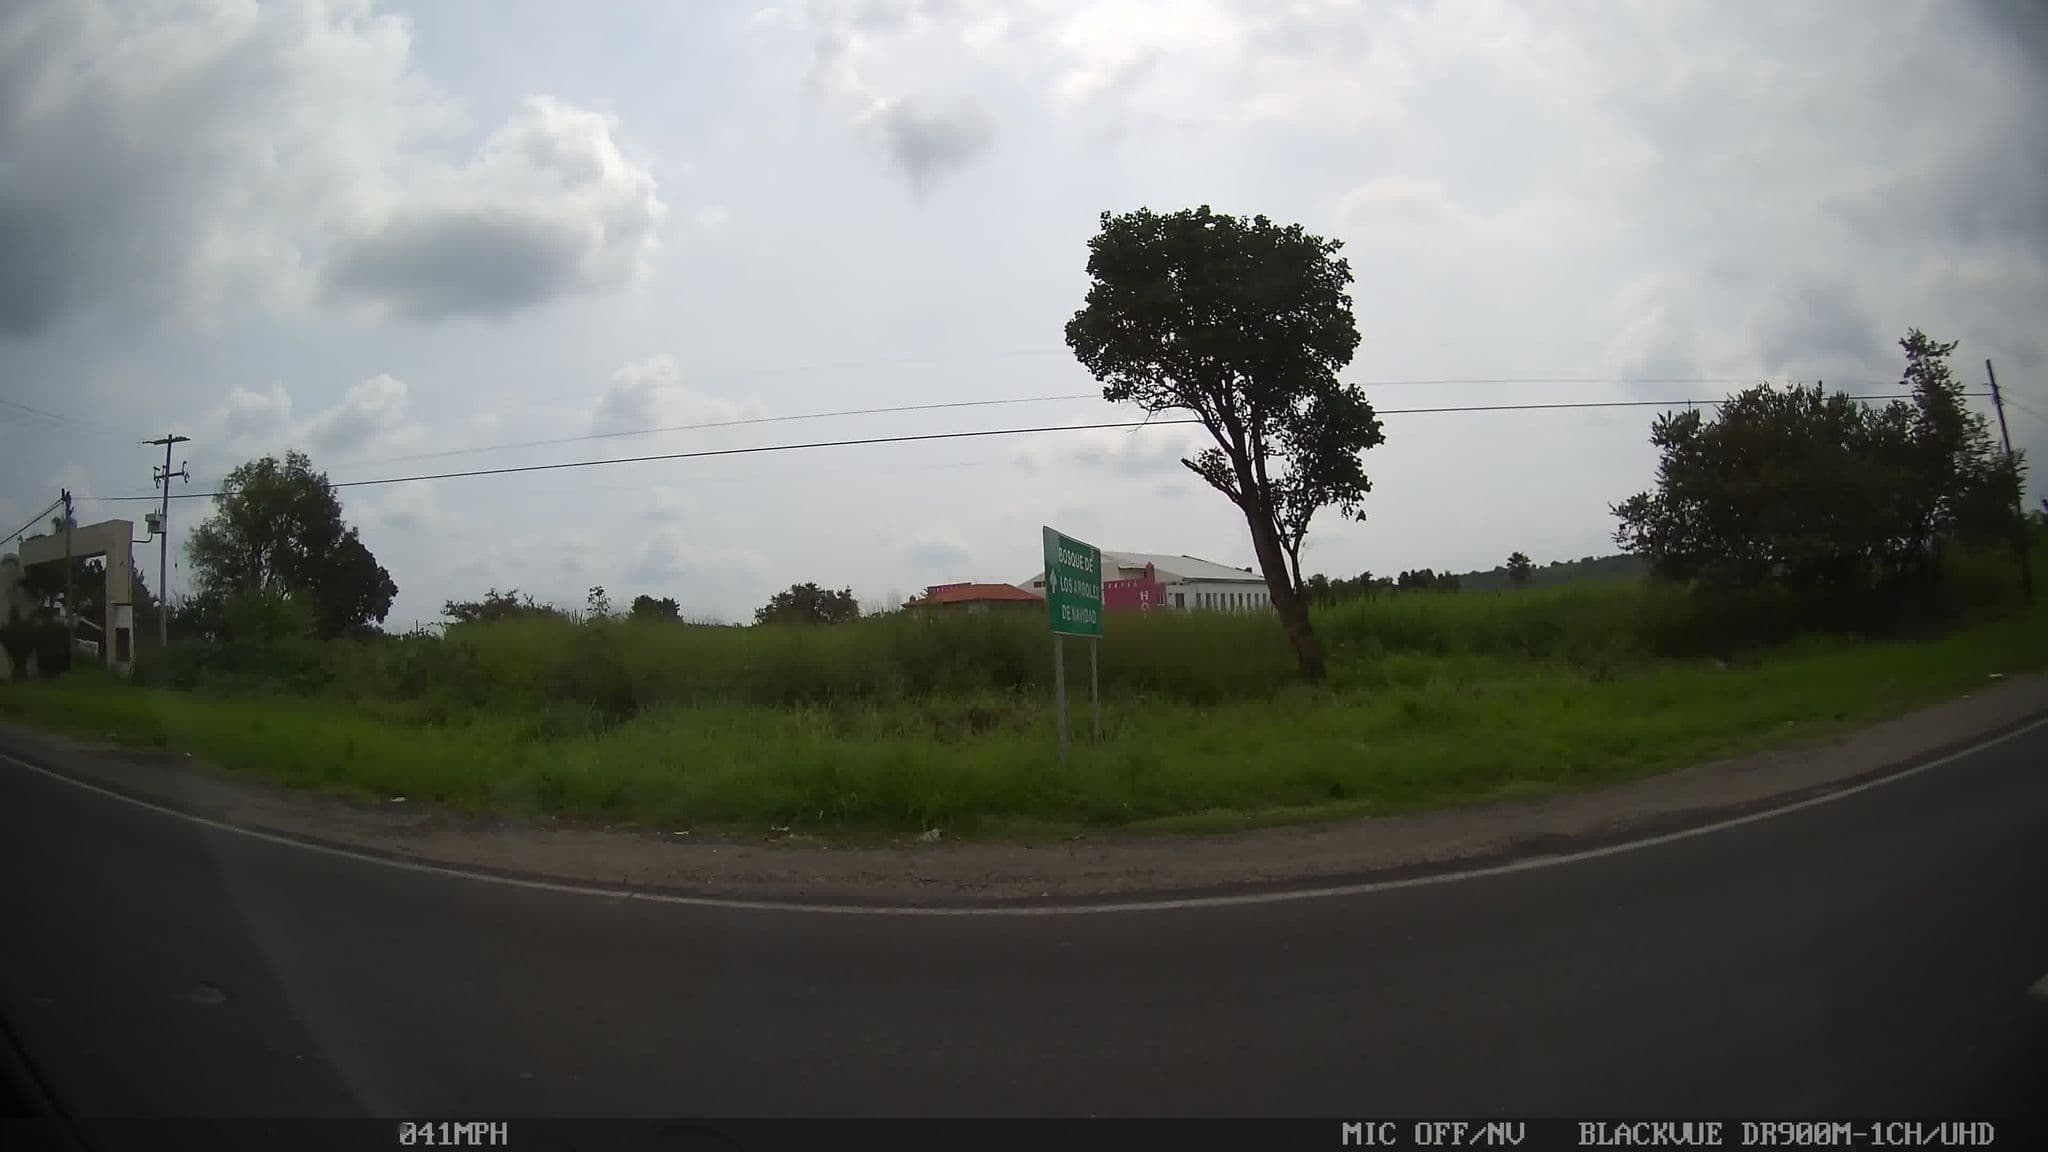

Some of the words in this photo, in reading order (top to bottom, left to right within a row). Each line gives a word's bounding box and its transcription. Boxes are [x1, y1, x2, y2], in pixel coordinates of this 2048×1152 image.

[1058, 547, 1084, 570] BOSQUE
[1085, 556, 1094, 573] DE
[1060, 576, 1073, 594] LOS
[1062, 604, 1071, 621] DE
[1071, 607, 1097, 624] NAVIDAD
